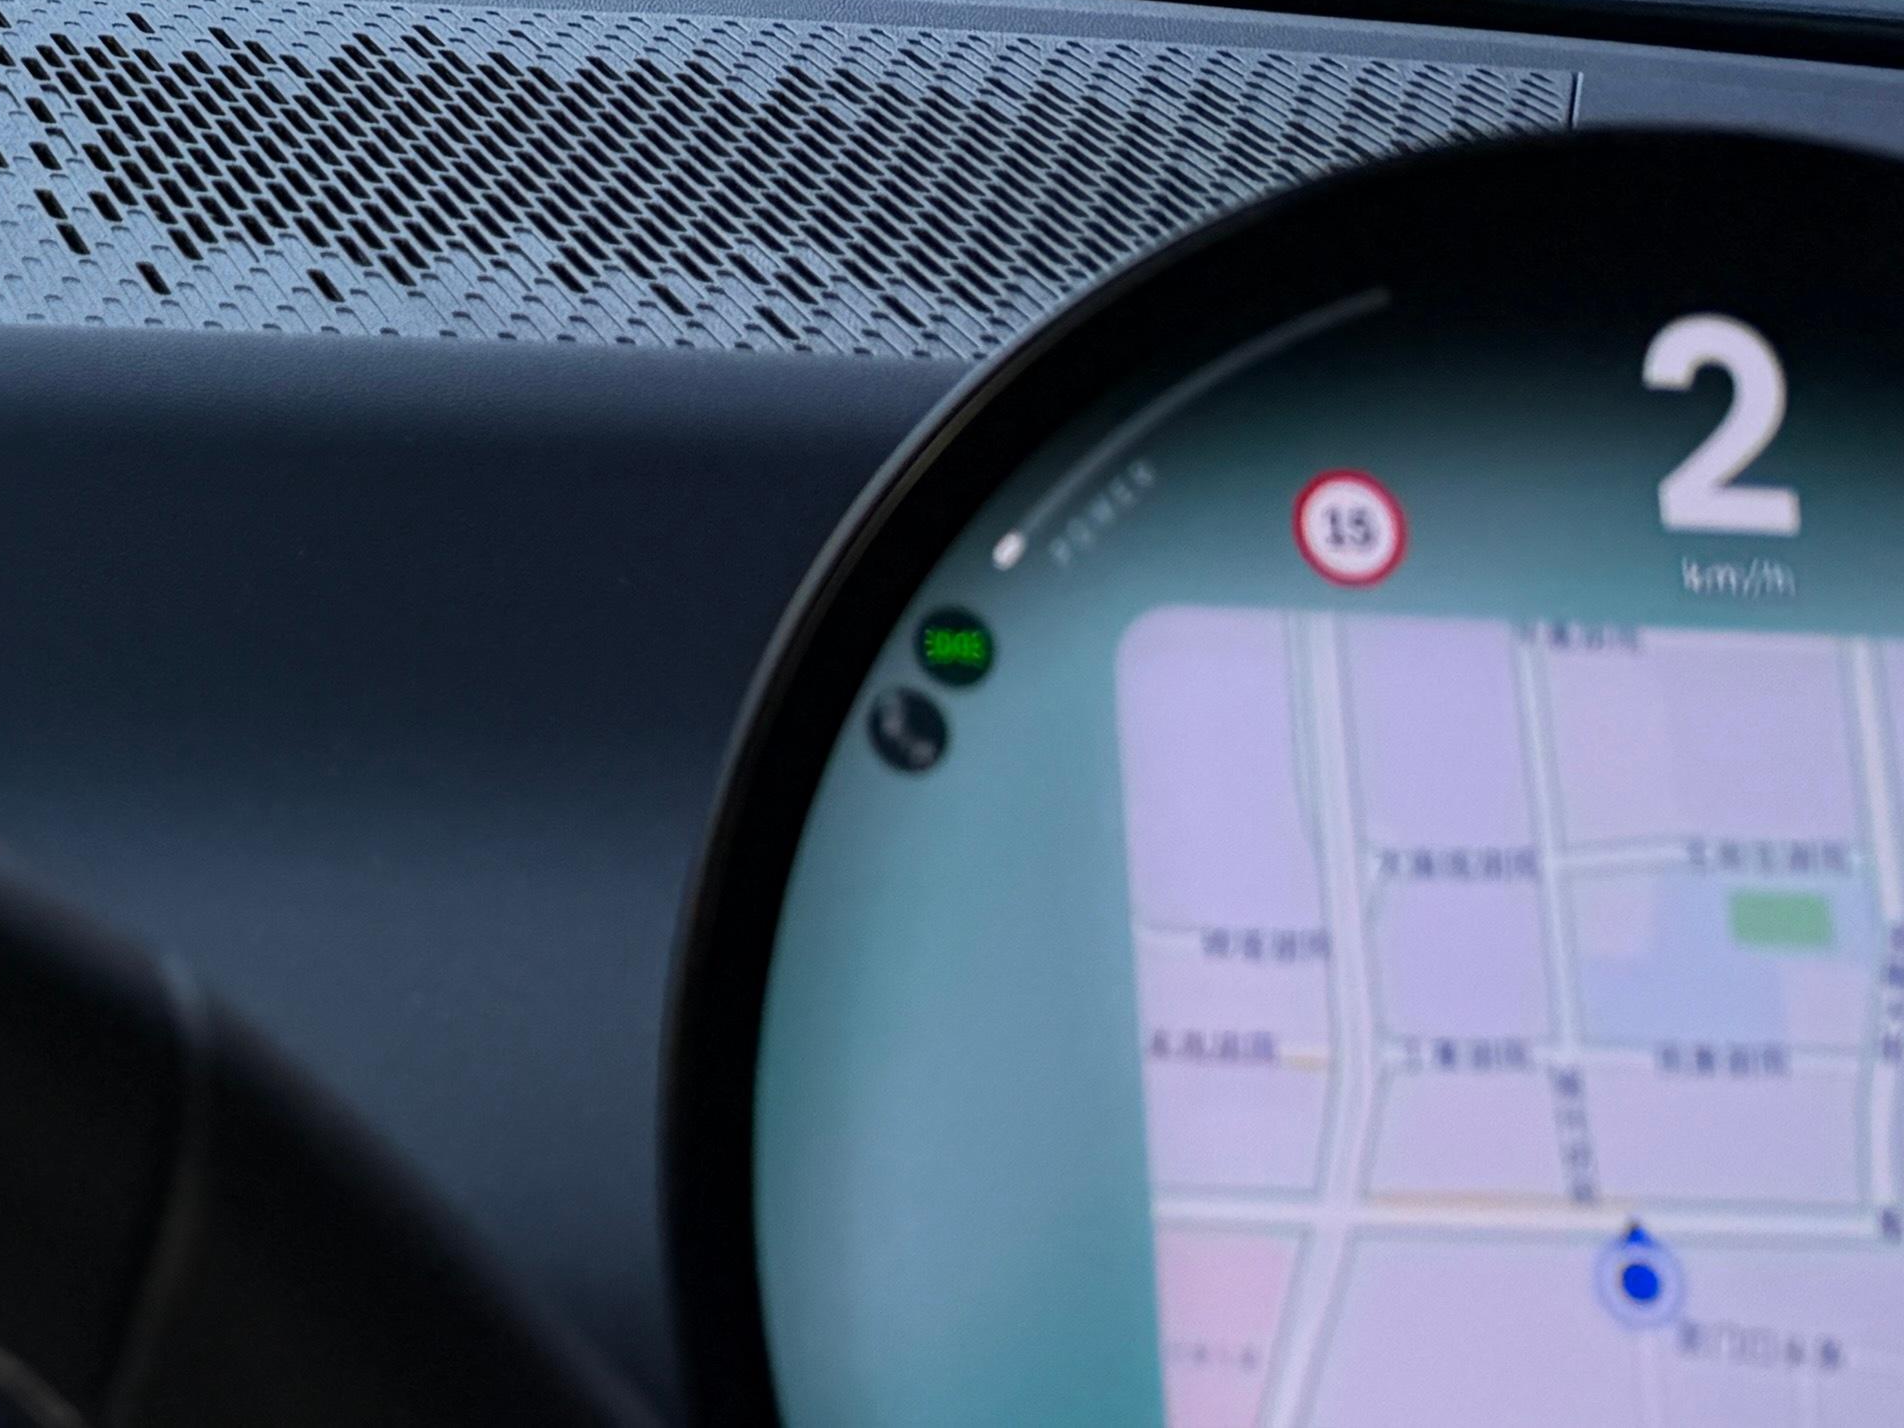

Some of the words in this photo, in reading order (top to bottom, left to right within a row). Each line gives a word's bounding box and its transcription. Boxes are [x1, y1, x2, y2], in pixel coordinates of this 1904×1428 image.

[1642, 313, 1801, 537] 2
[1323, 504, 1380, 547] 15
[1681, 556, 1794, 598] km/h
